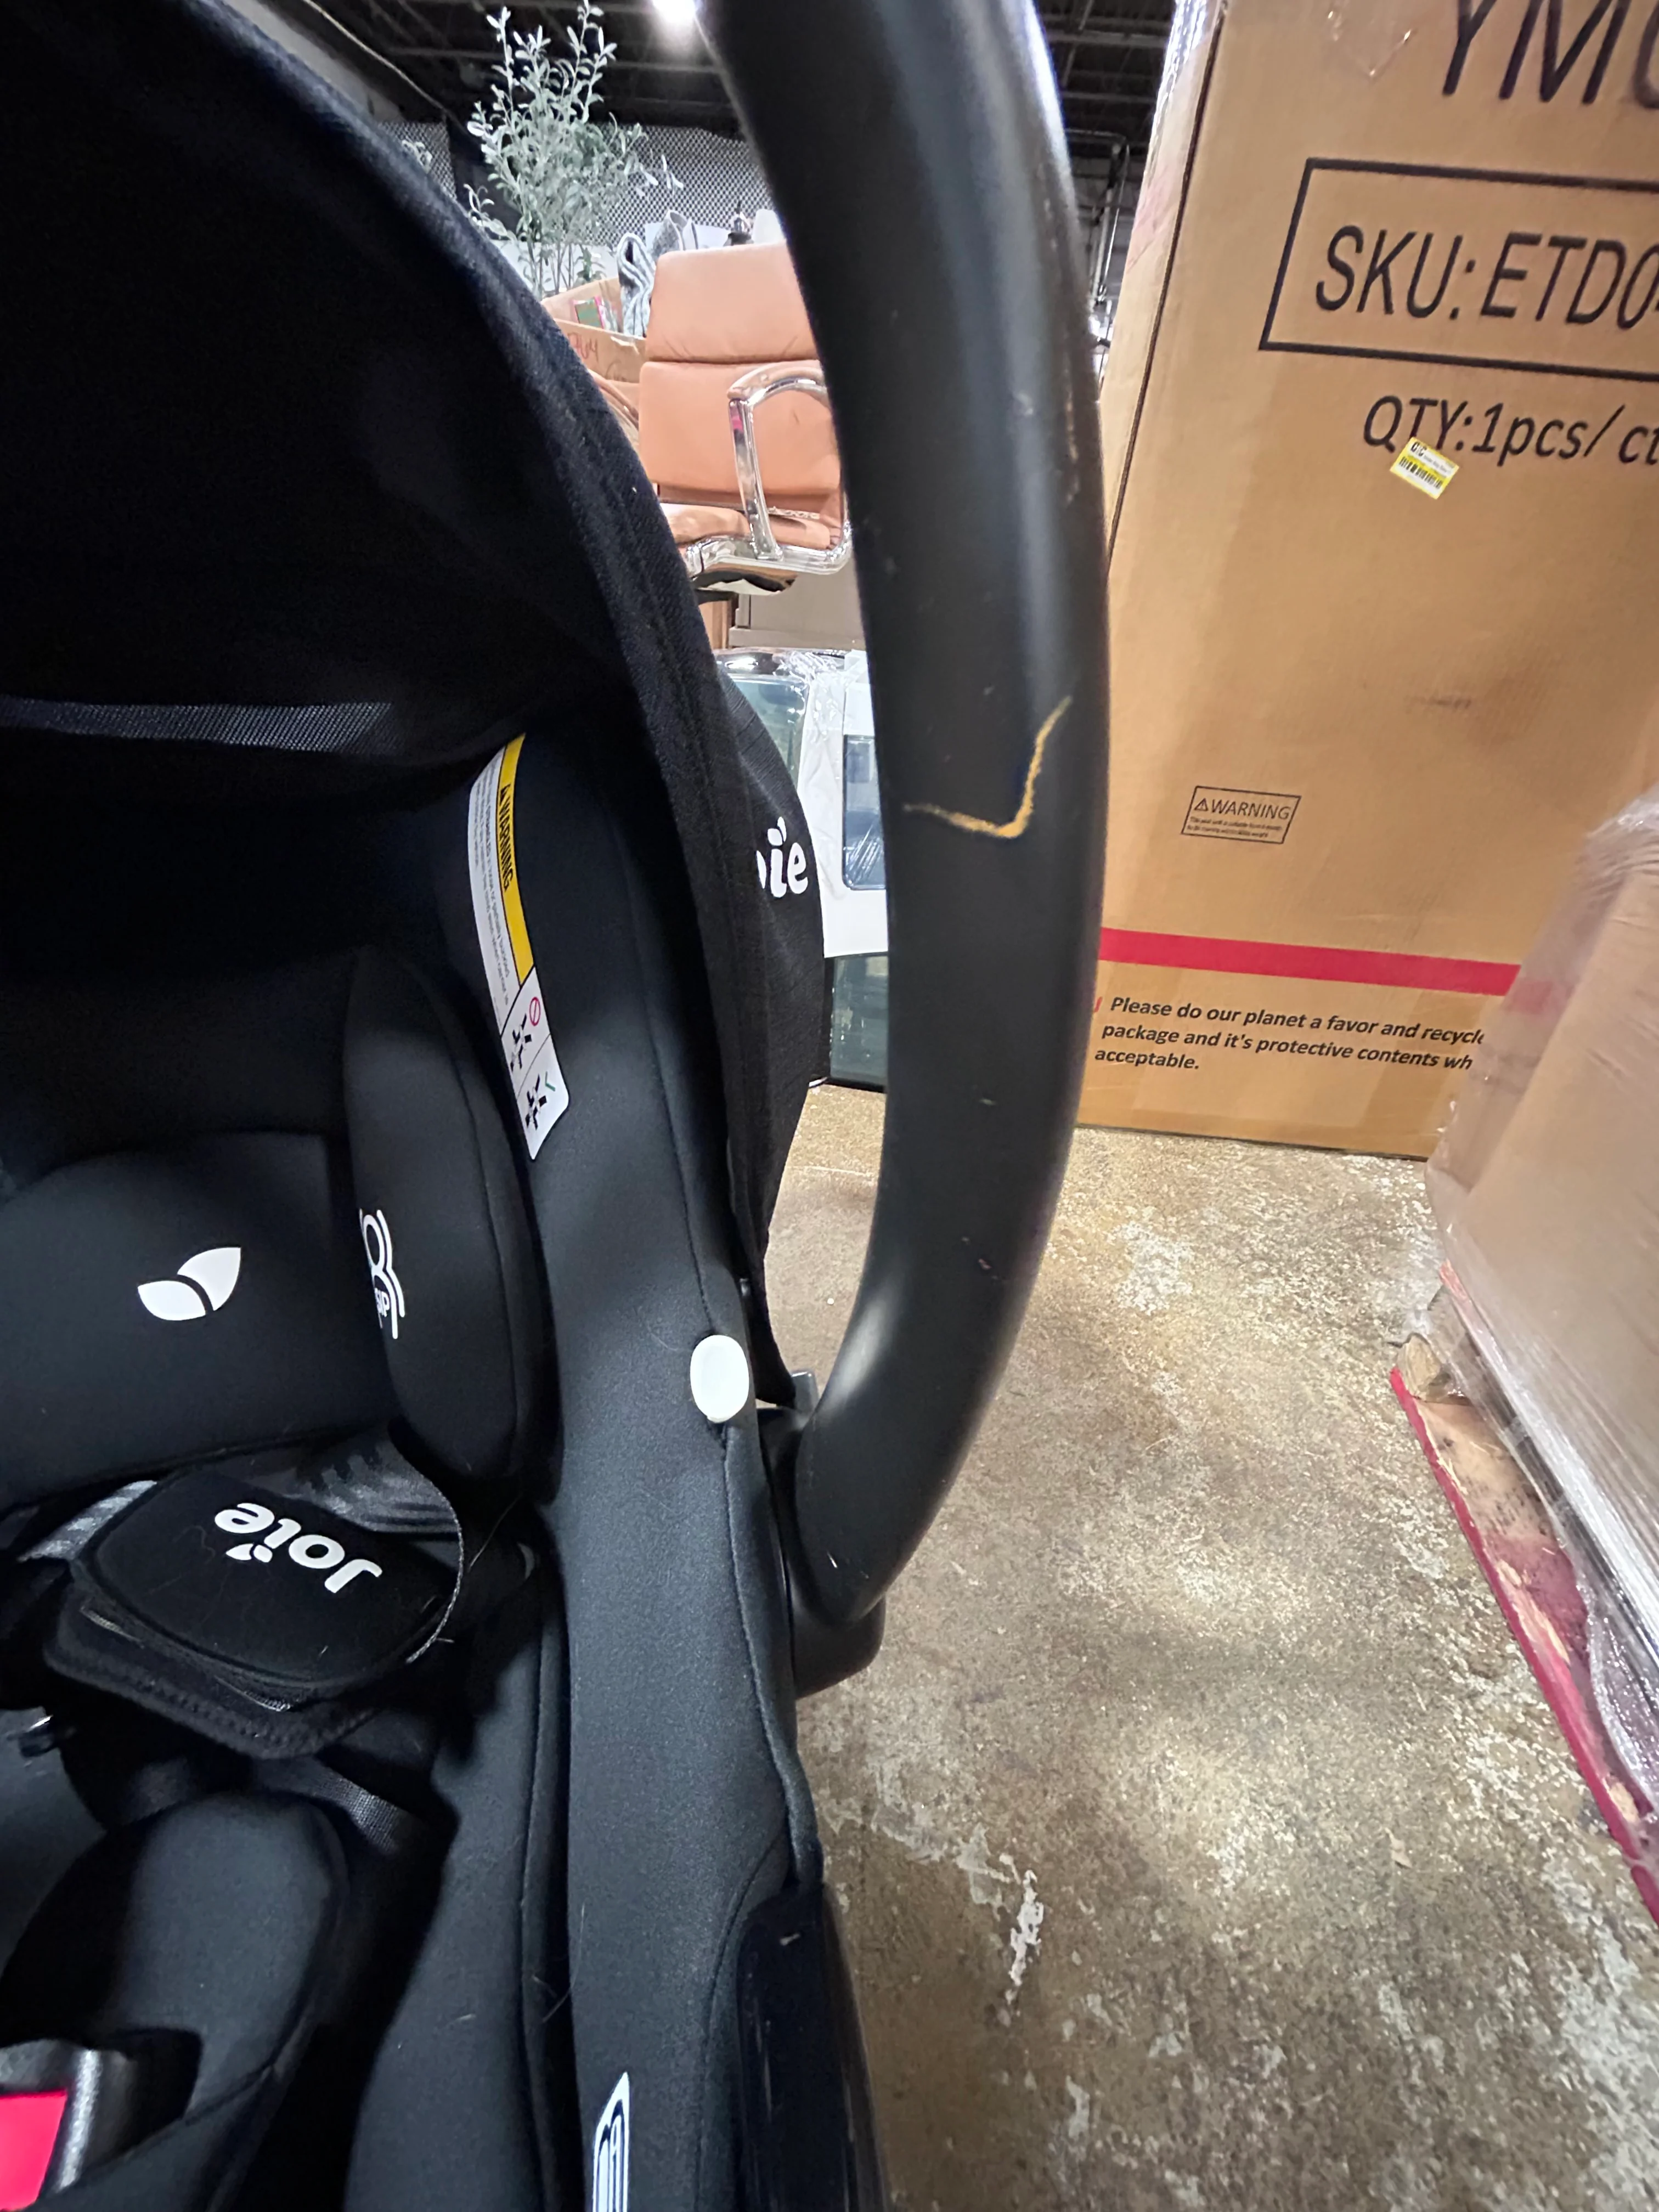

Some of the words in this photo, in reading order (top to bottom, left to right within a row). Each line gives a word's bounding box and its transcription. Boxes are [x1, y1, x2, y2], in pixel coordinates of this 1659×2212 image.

[1316, 225, 1659, 329] SKU:ETD0
[1211, 799, 1291, 820] WARNING
[499, 796, 514, 892] WARNING
[1110, 996, 1172, 1015] Please
[1177, 1003, 1202, 1019] do
[1207, 1008, 1242, 1022] our
[1243, 1009, 1307, 1028] planet
[1310, 1017, 1322, 1029] a
[1327, 1015, 1379, 1034] favor
[1381, 1023, 1421, 1039] and
[1094, 1049, 1199, 1069] acceptable.
[1102, 1025, 1179, 1044] package
[1184, 1031, 1222, 1046] and
[1224, 1034, 1253, 1049] it's
[1255, 1039, 1353, 1058] protective
[1357, 1048, 1440, 1067] contents
[215, 1503, 383, 1594] Joie
